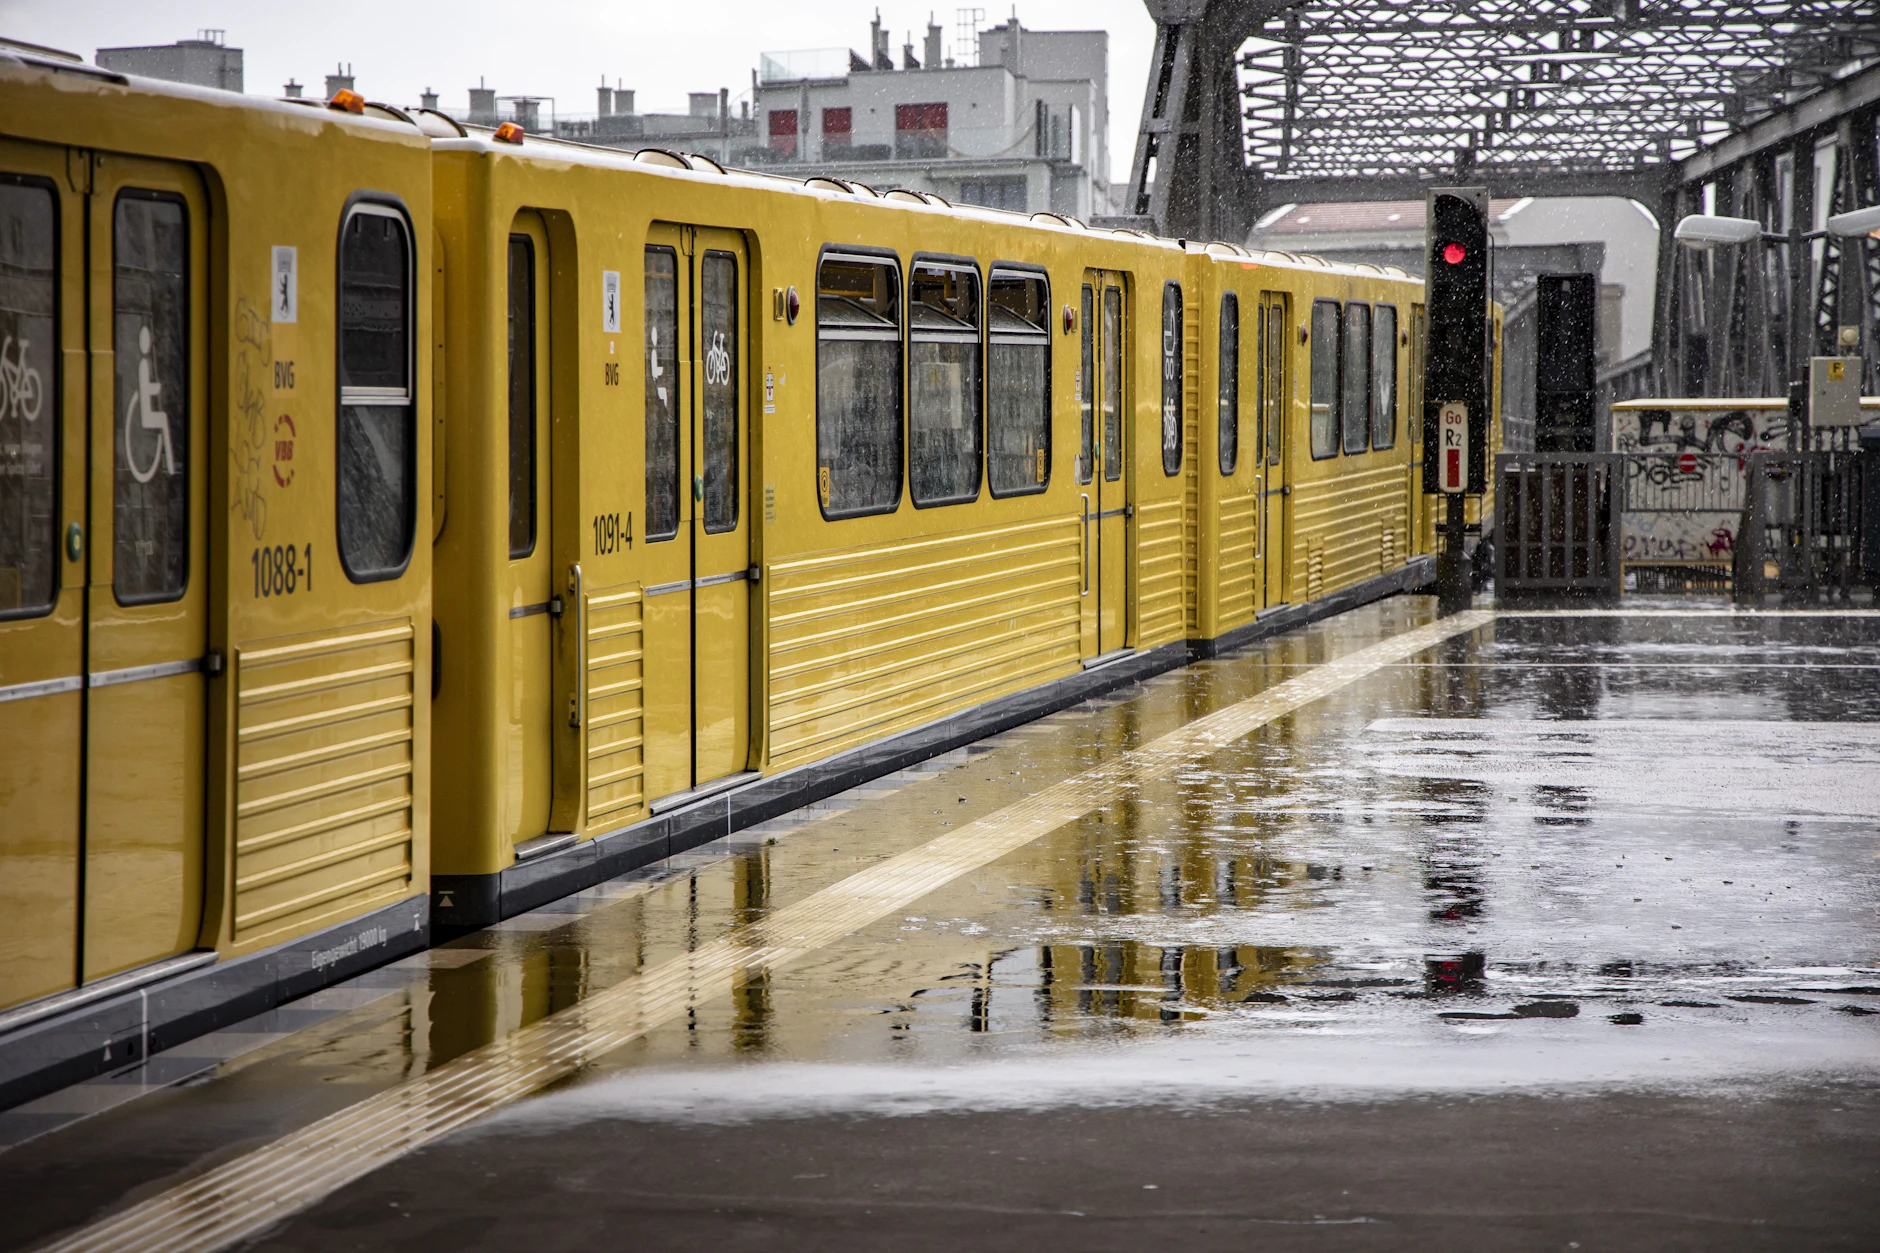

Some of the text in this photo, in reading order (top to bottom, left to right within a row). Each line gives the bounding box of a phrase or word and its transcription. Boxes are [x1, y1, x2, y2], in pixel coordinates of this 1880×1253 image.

[274, 360, 295, 390] BVG
[605, 362, 619, 386] BVG
[1833, 362, 1841, 373] F
[1446, 410, 1462, 424] Go
[1446, 428, 1462, 446] R2
[275, 440, 294, 461] VBB
[593, 511, 633, 556] 1091-4
[252, 542, 312, 599] 1088-1
[312, 936, 359, 972] Eigengewicht
